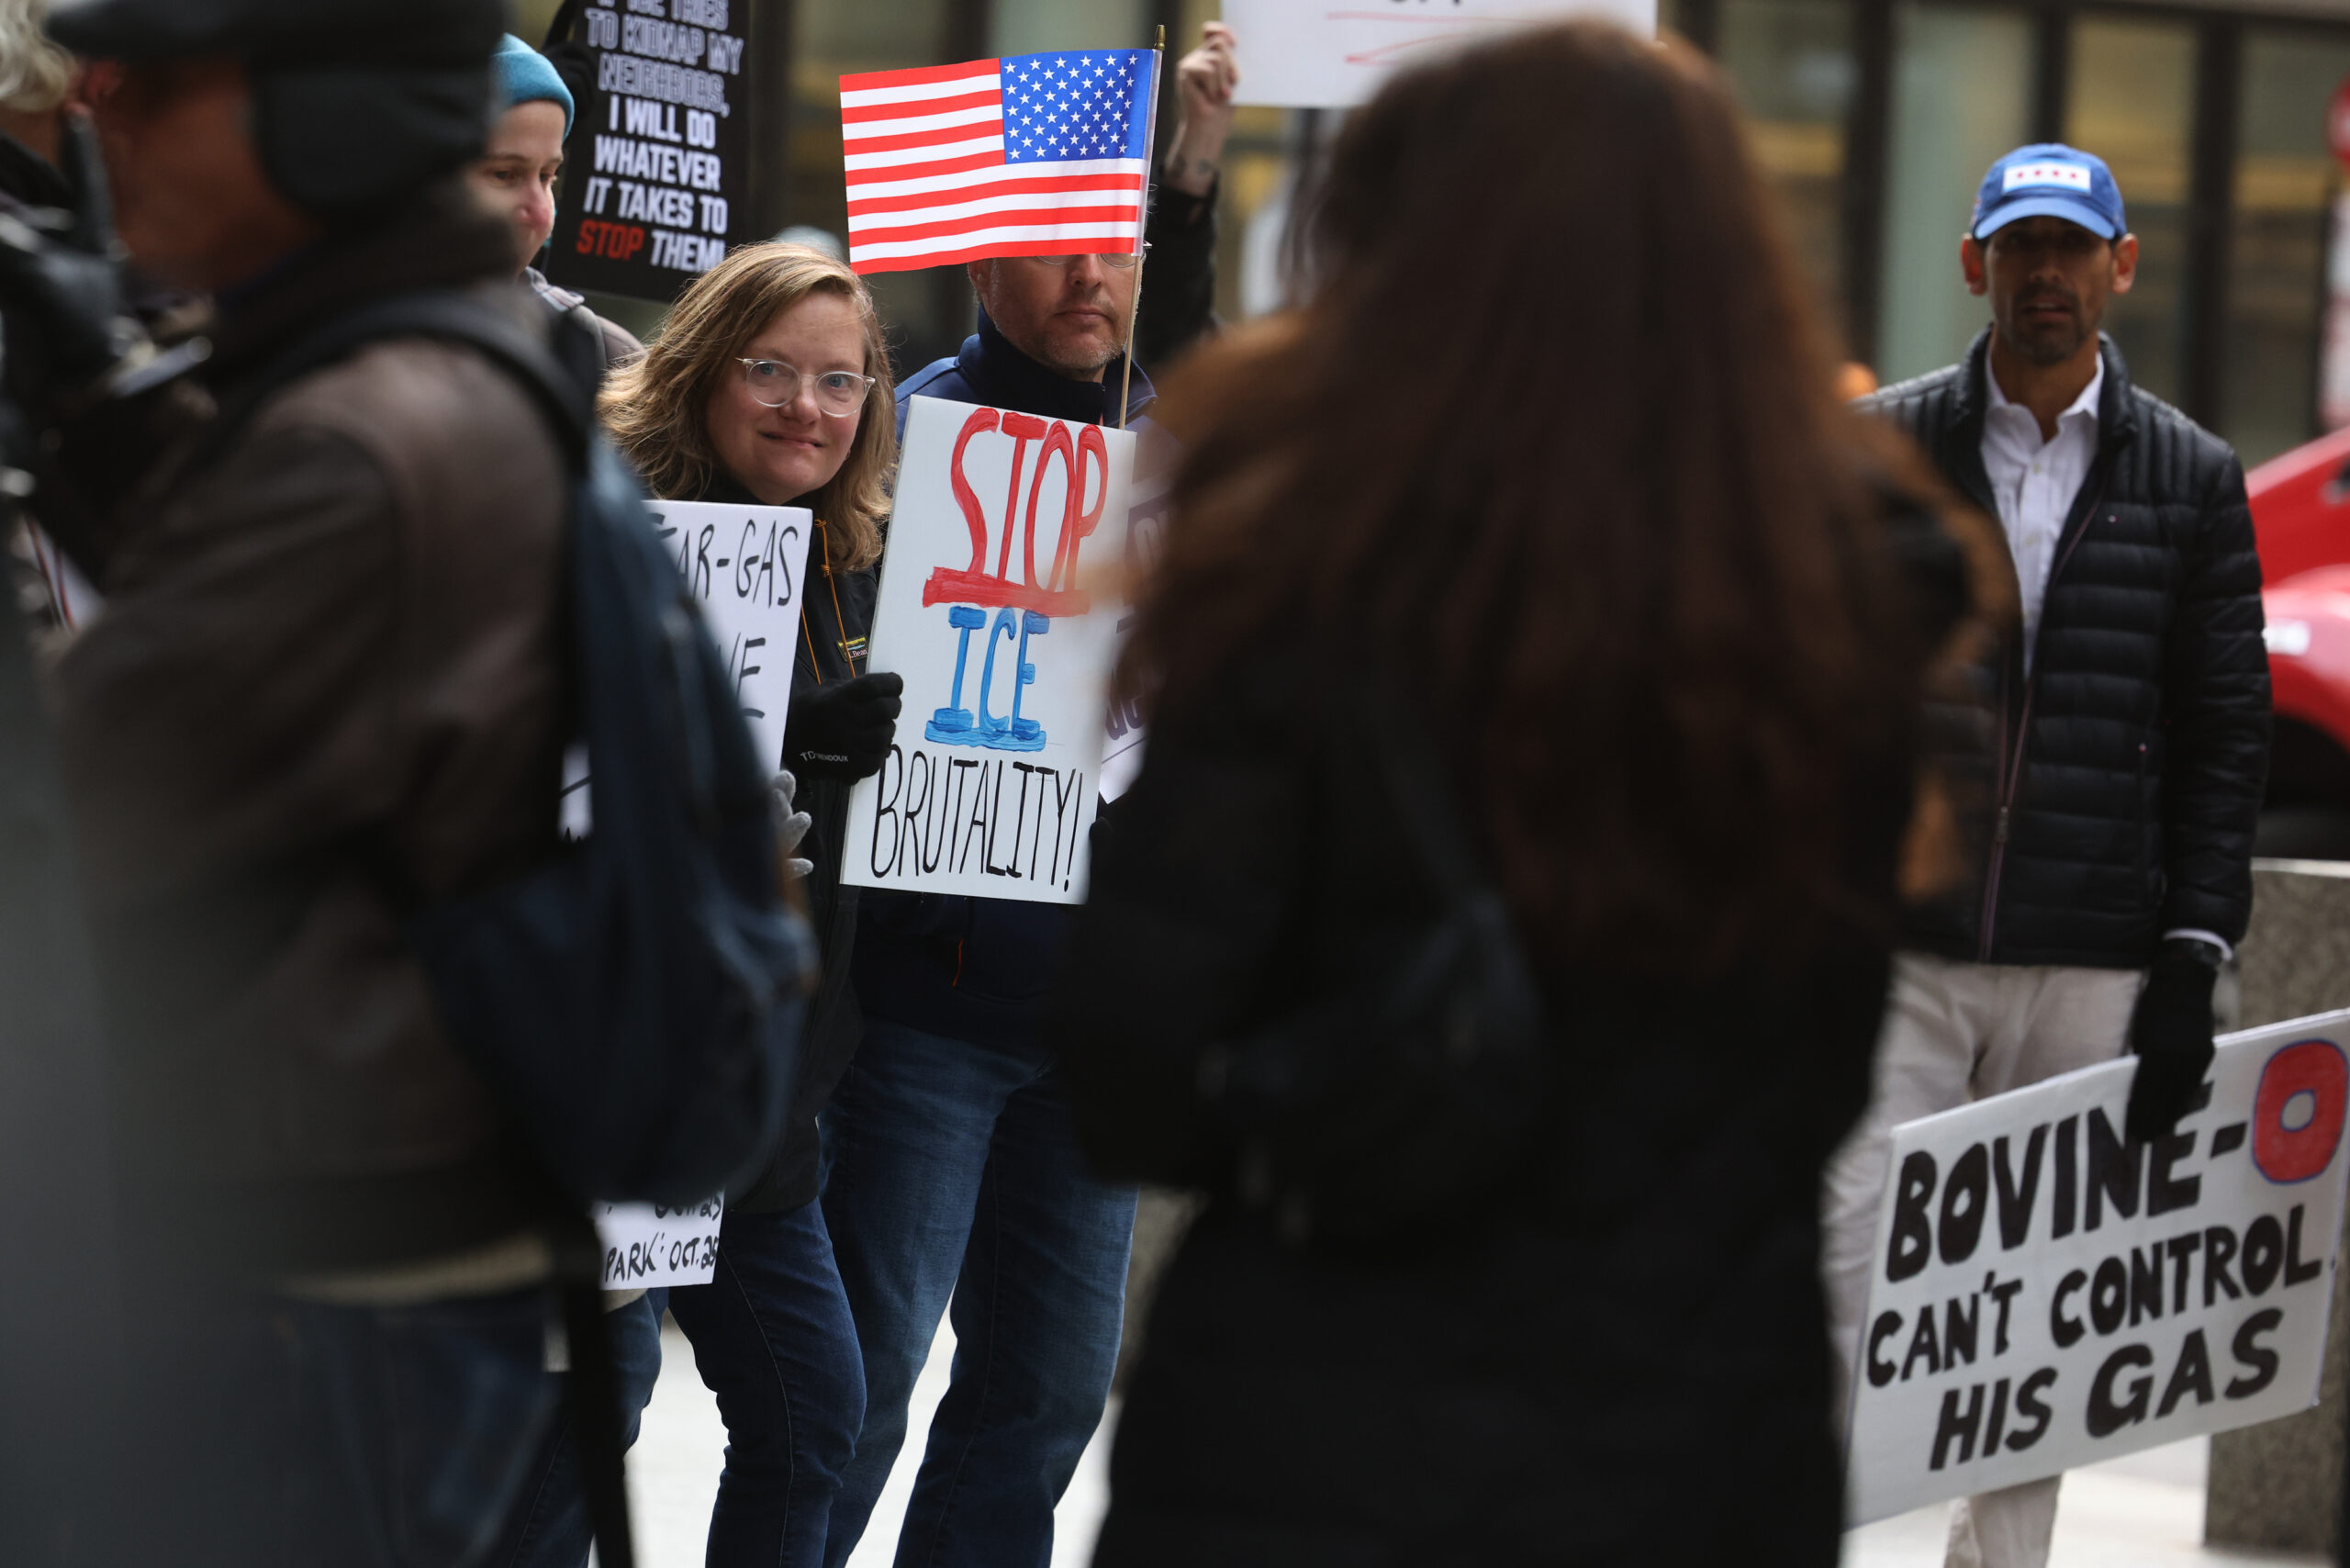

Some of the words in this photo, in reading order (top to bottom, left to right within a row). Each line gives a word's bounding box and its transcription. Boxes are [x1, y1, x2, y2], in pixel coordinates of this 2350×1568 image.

[585, 7, 620, 50] TO
[621, 13, 706, 66] KIDNAP
[707, 31, 744, 75] MY
[594, 133, 722, 192] WHATEVER
[609, 94, 620, 131] I
[625, 96, 683, 143] WILL
[687, 108, 716, 150] DO
[576, 218, 644, 261] STOP
[583, 175, 613, 215] IT
[618, 179, 695, 229] TAKES
[699, 194, 728, 235] TO
[950, 407, 1109, 592] STOP
[933, 606, 1050, 740] ICE
[870, 744, 1084, 892] BRUTALITY!
[1867, 1271, 2023, 1388] CAN'T
[2049, 1203, 2324, 1350] CONTROL
[1929, 1366, 2060, 1472] HIS
[2086, 1307, 2285, 1439] GAS
